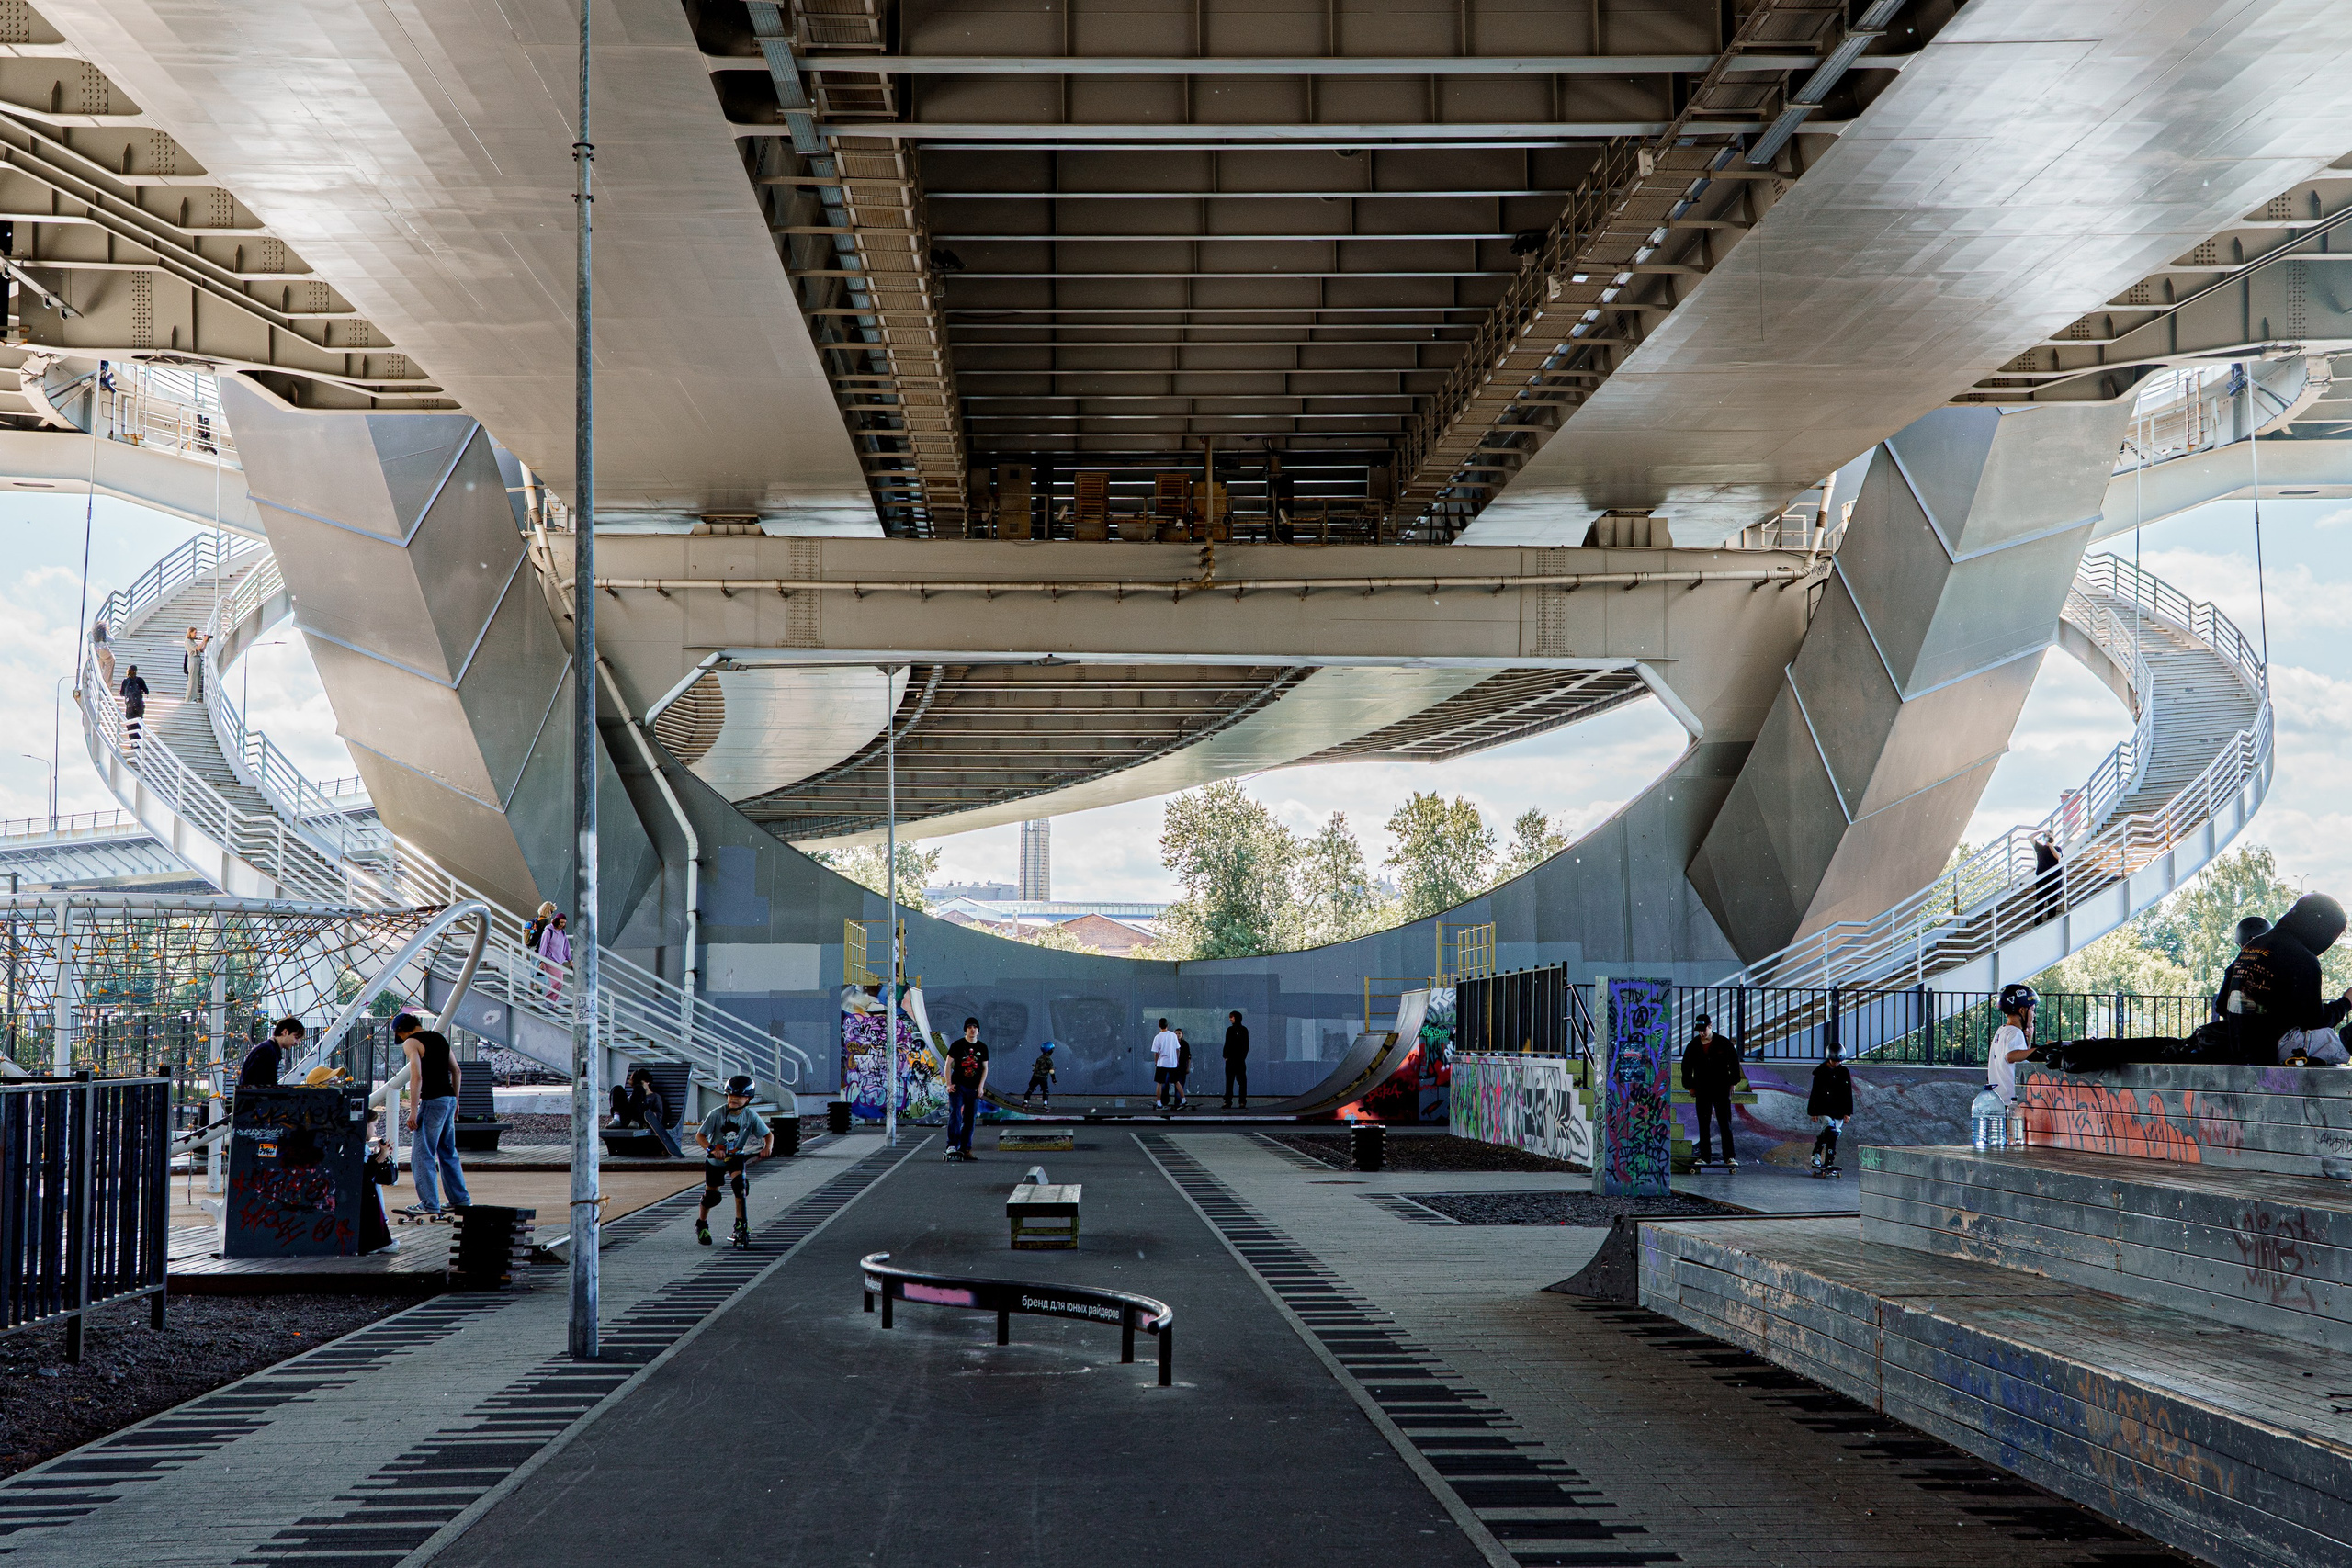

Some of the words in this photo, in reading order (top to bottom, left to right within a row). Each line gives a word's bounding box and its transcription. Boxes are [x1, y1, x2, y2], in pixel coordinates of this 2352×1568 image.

[1022, 1295, 1048, 1310] бренд
[1050, 1301, 1065, 1311] для
[1067, 1303, 1087, 1314] юных
[1089, 1304, 1119, 1320] райдеров
